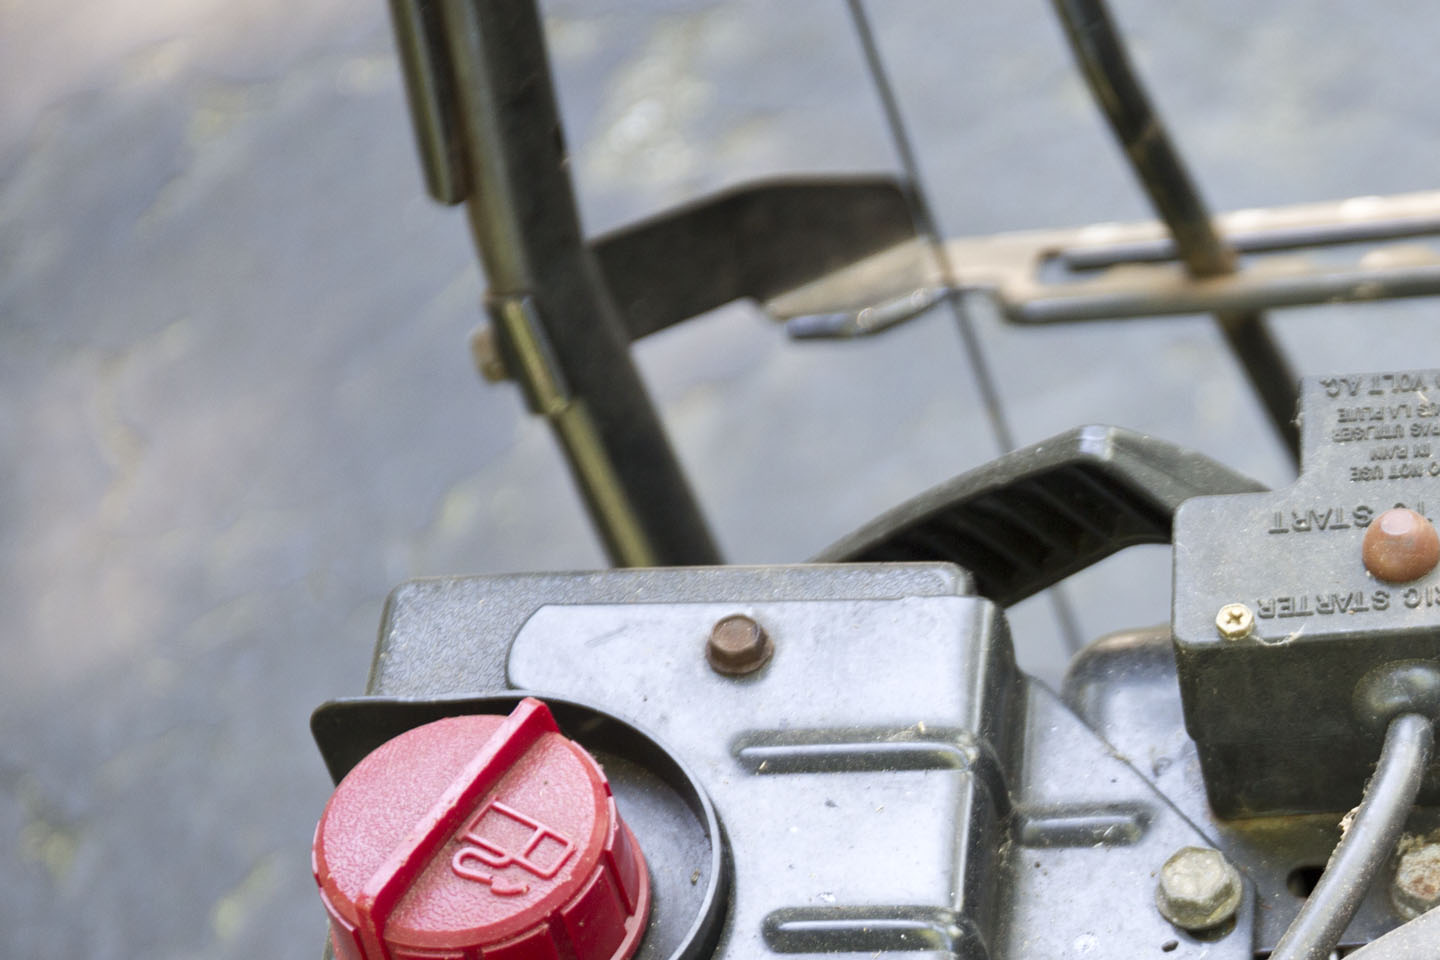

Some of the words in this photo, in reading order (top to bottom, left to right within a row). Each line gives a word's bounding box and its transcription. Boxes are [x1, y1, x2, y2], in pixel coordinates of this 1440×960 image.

[1368, 374, 1427, 396] VOLT
[1332, 424, 1404, 443] UTILISER
[1370, 446, 1408, 461] RAIN
[1349, 465, 1383, 482] USE
[1388, 464, 1424, 480] NOT
[1267, 505, 1374, 535] START
[1257, 591, 1390, 619] STARTER
